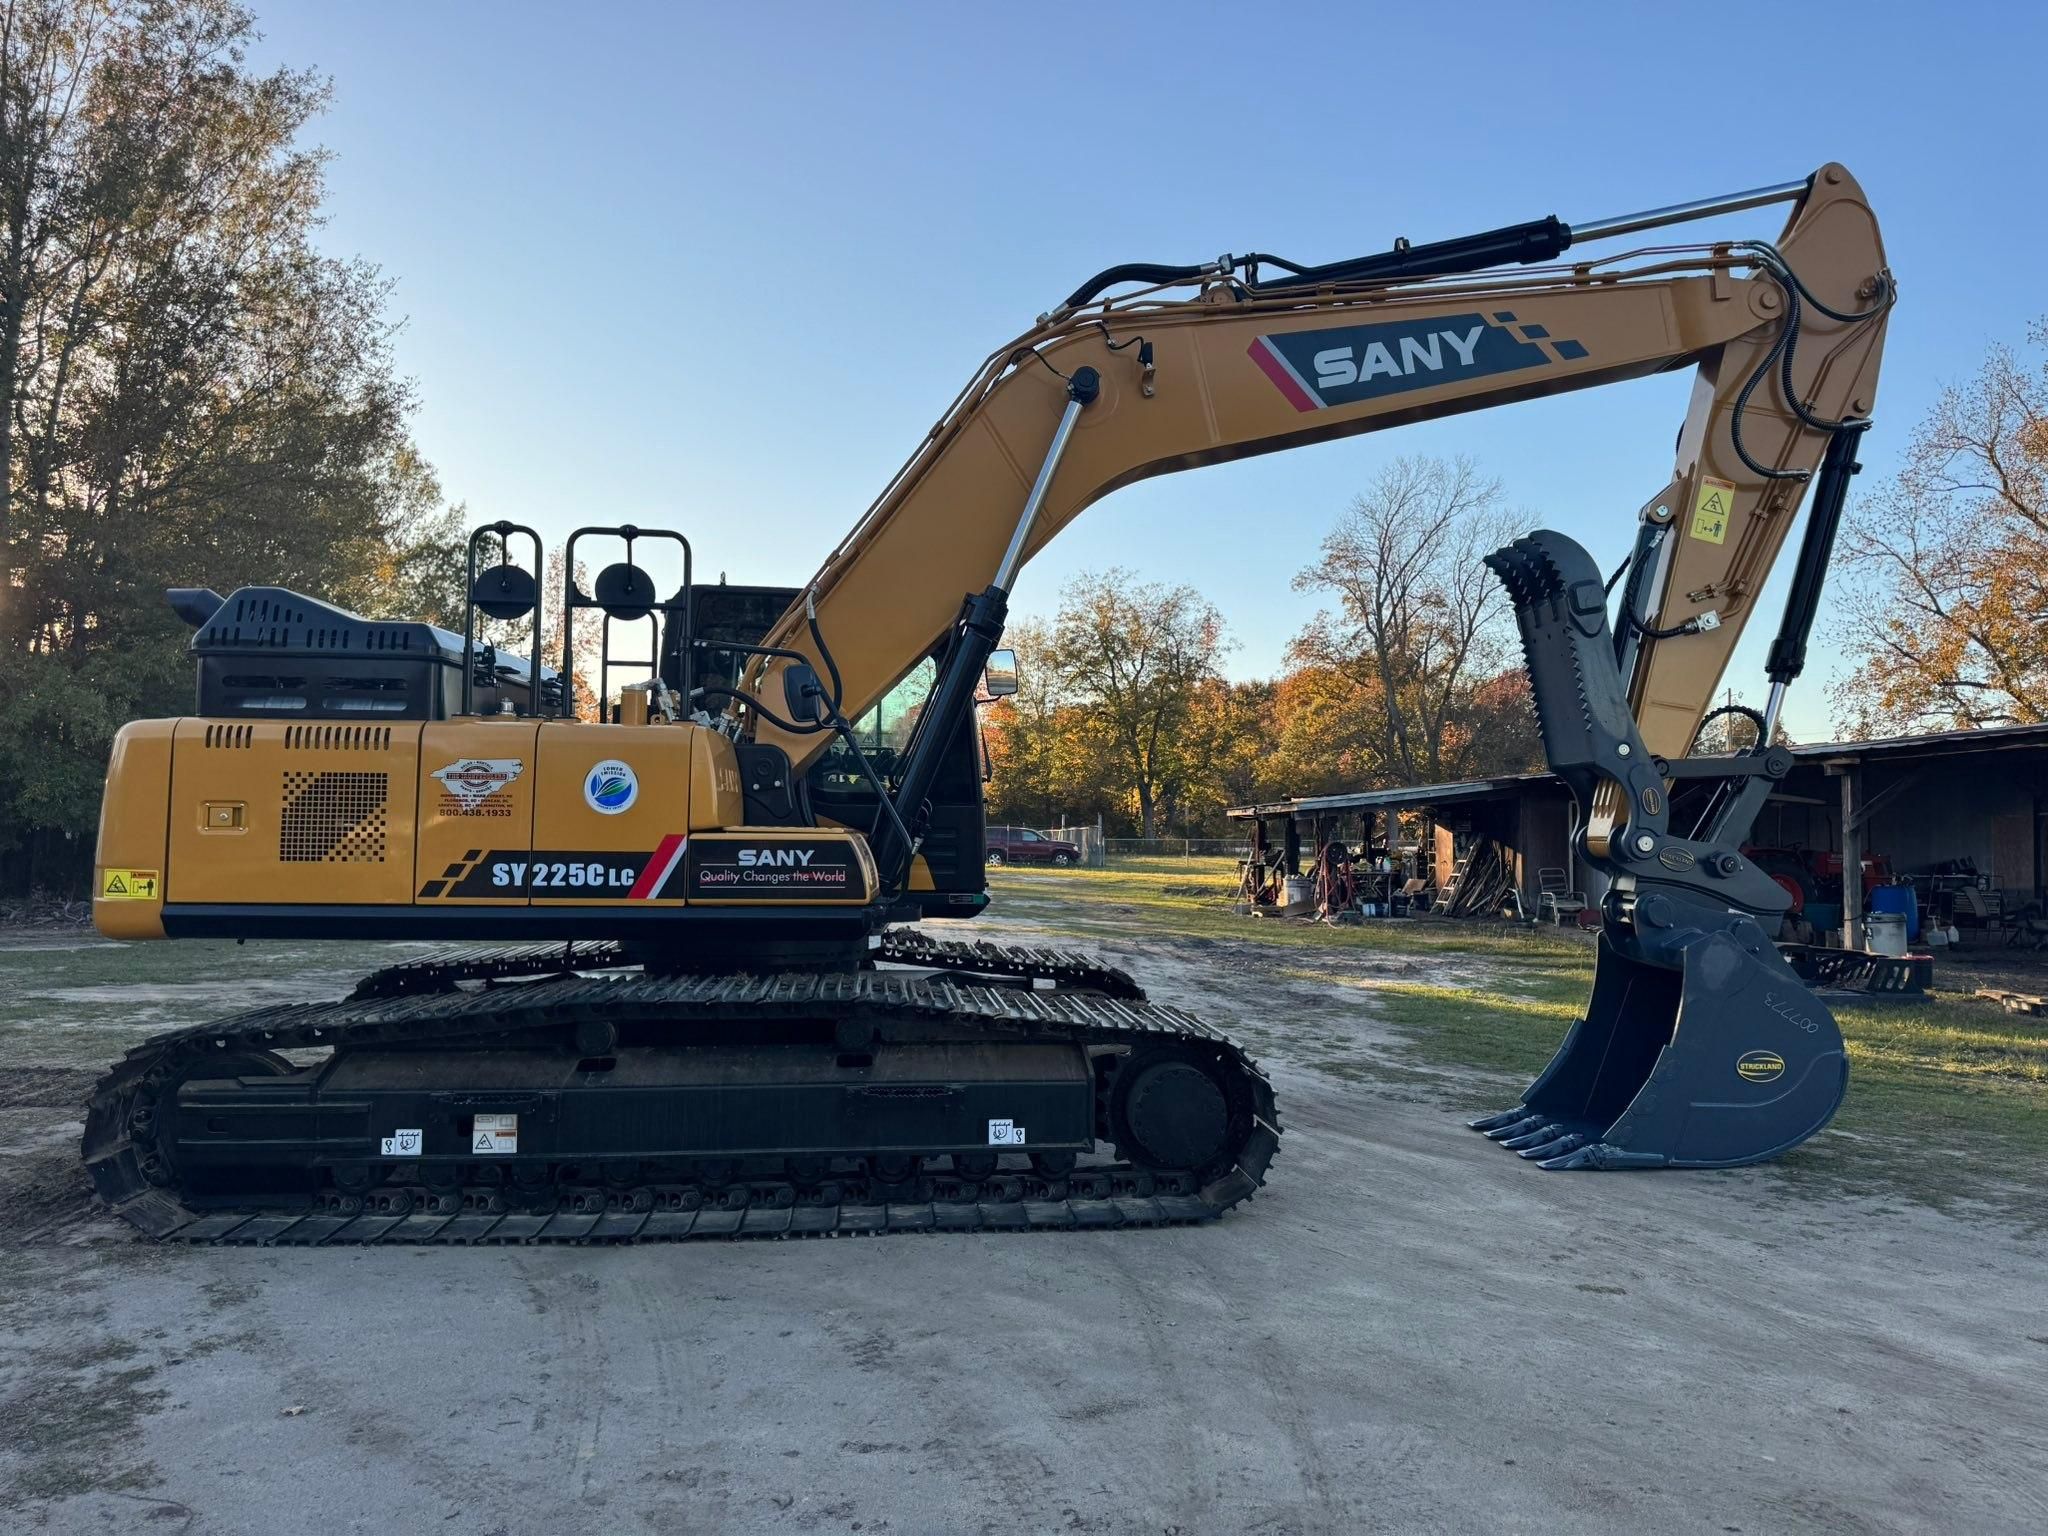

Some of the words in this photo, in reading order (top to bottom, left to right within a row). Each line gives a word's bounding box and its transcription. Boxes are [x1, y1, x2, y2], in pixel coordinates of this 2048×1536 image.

[1313, 325, 1484, 388] SANY
[738, 849, 815, 866] SANY
[492, 863, 527, 886] SY
[608, 868, 635, 886] LC
[700, 869, 740, 884] Quality
[743, 869, 790, 884] Changes
[792, 870, 809, 882] the
[812, 870, 845, 882] World
